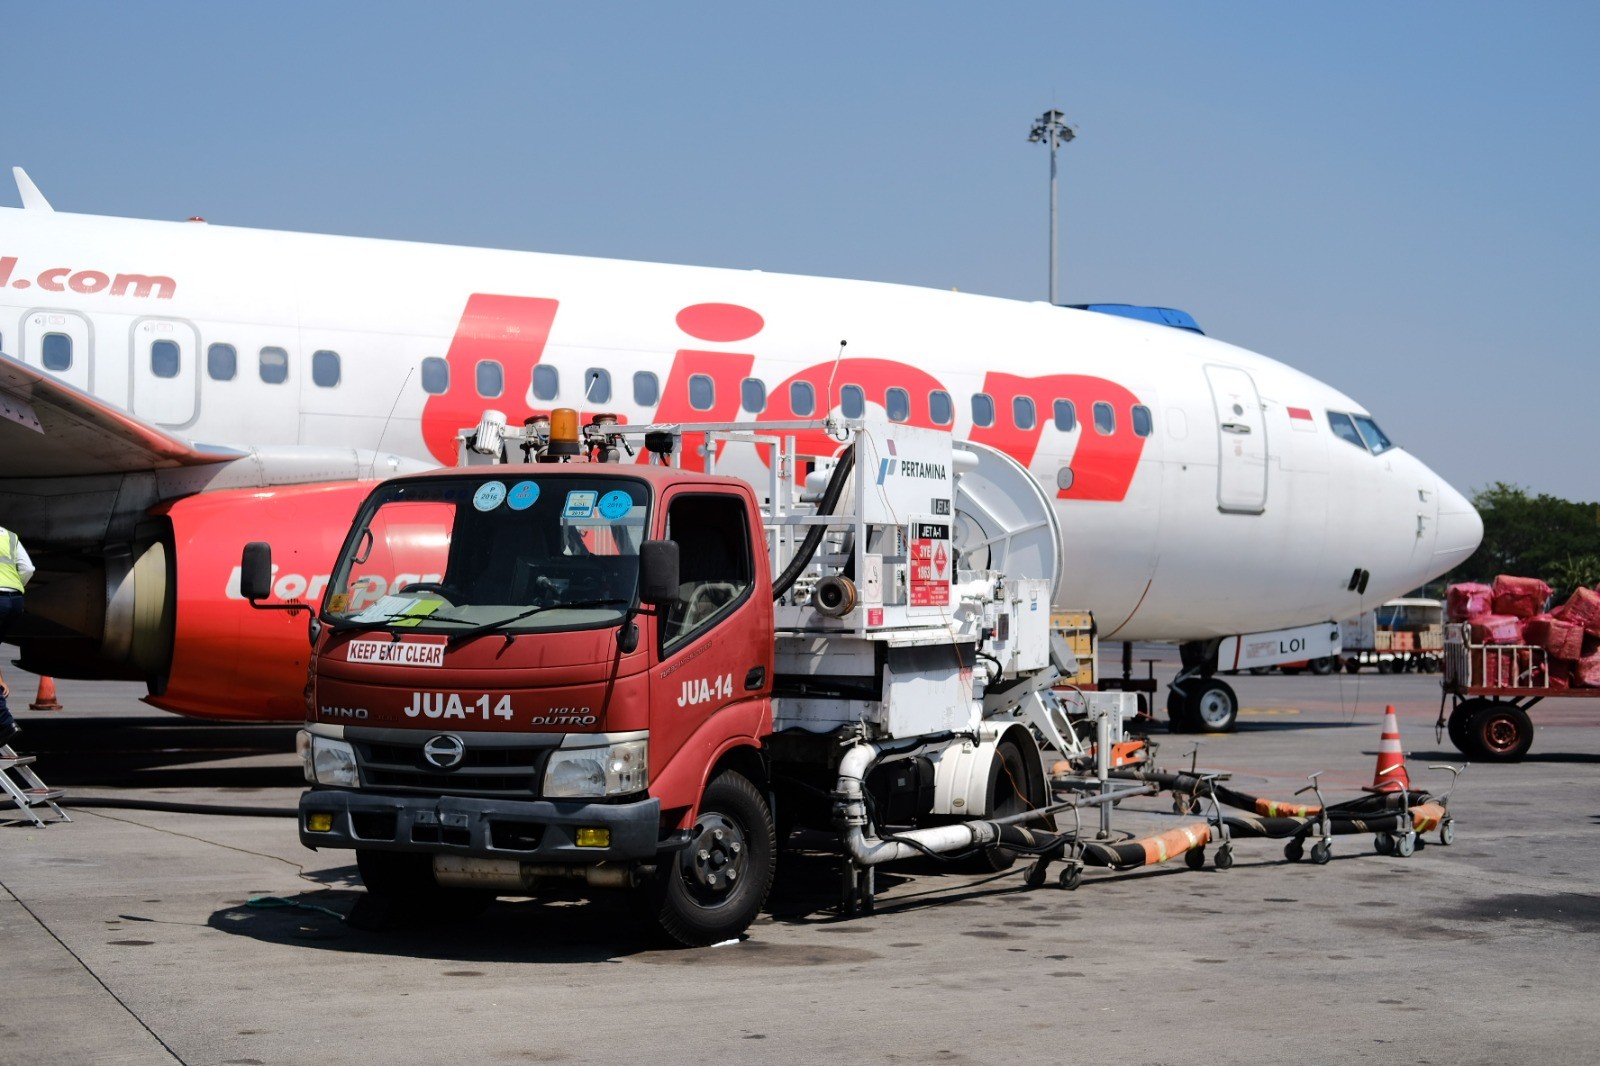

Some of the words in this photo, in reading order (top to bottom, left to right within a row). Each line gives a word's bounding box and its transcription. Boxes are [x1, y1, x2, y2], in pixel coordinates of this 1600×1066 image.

[901, 460, 947, 480] PERTAMINA
[922, 525, 932, 538] JET
[932, 526, 942, 539] A-1
[350, 642, 377, 660] KEEP
[379, 644, 404, 661] EXIT
[406, 645, 442, 664] CLEAR
[1280, 638, 1306, 654] LOI
[677, 673, 733, 707] JUA-14
[321, 705, 369, 719] HINO
[404, 692, 513, 721] JUA-14
[531, 715, 597, 728] DUTRO
